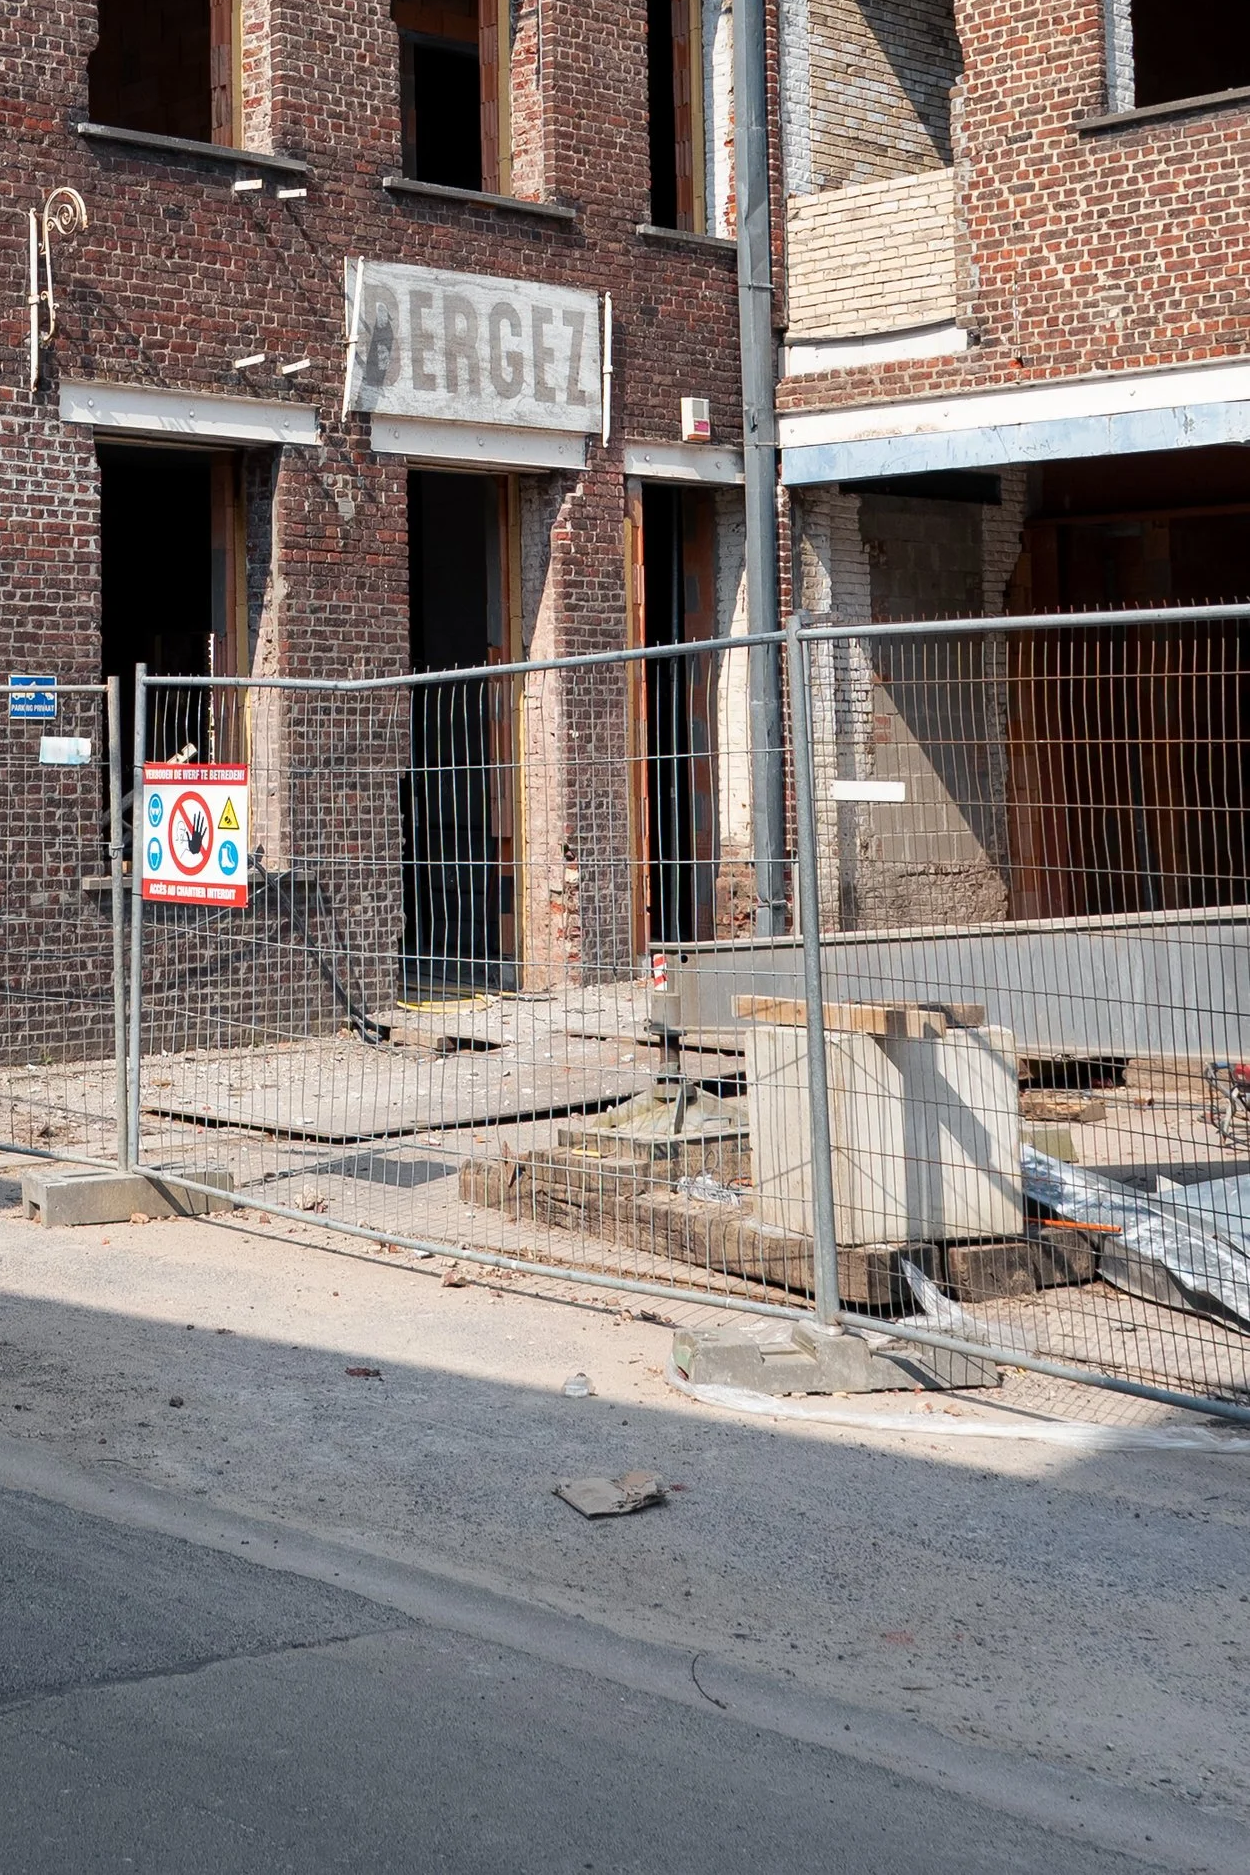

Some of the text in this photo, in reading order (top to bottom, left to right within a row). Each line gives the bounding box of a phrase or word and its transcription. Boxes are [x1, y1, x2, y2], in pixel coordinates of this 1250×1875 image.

[362, 282, 587, 407] BERGEZ
[145, 768, 245, 781] VERBODEN DE WERF TE BETREDEN!
[149, 882, 236, 900] ACCÈS AU CHANTIER INTERDIT
